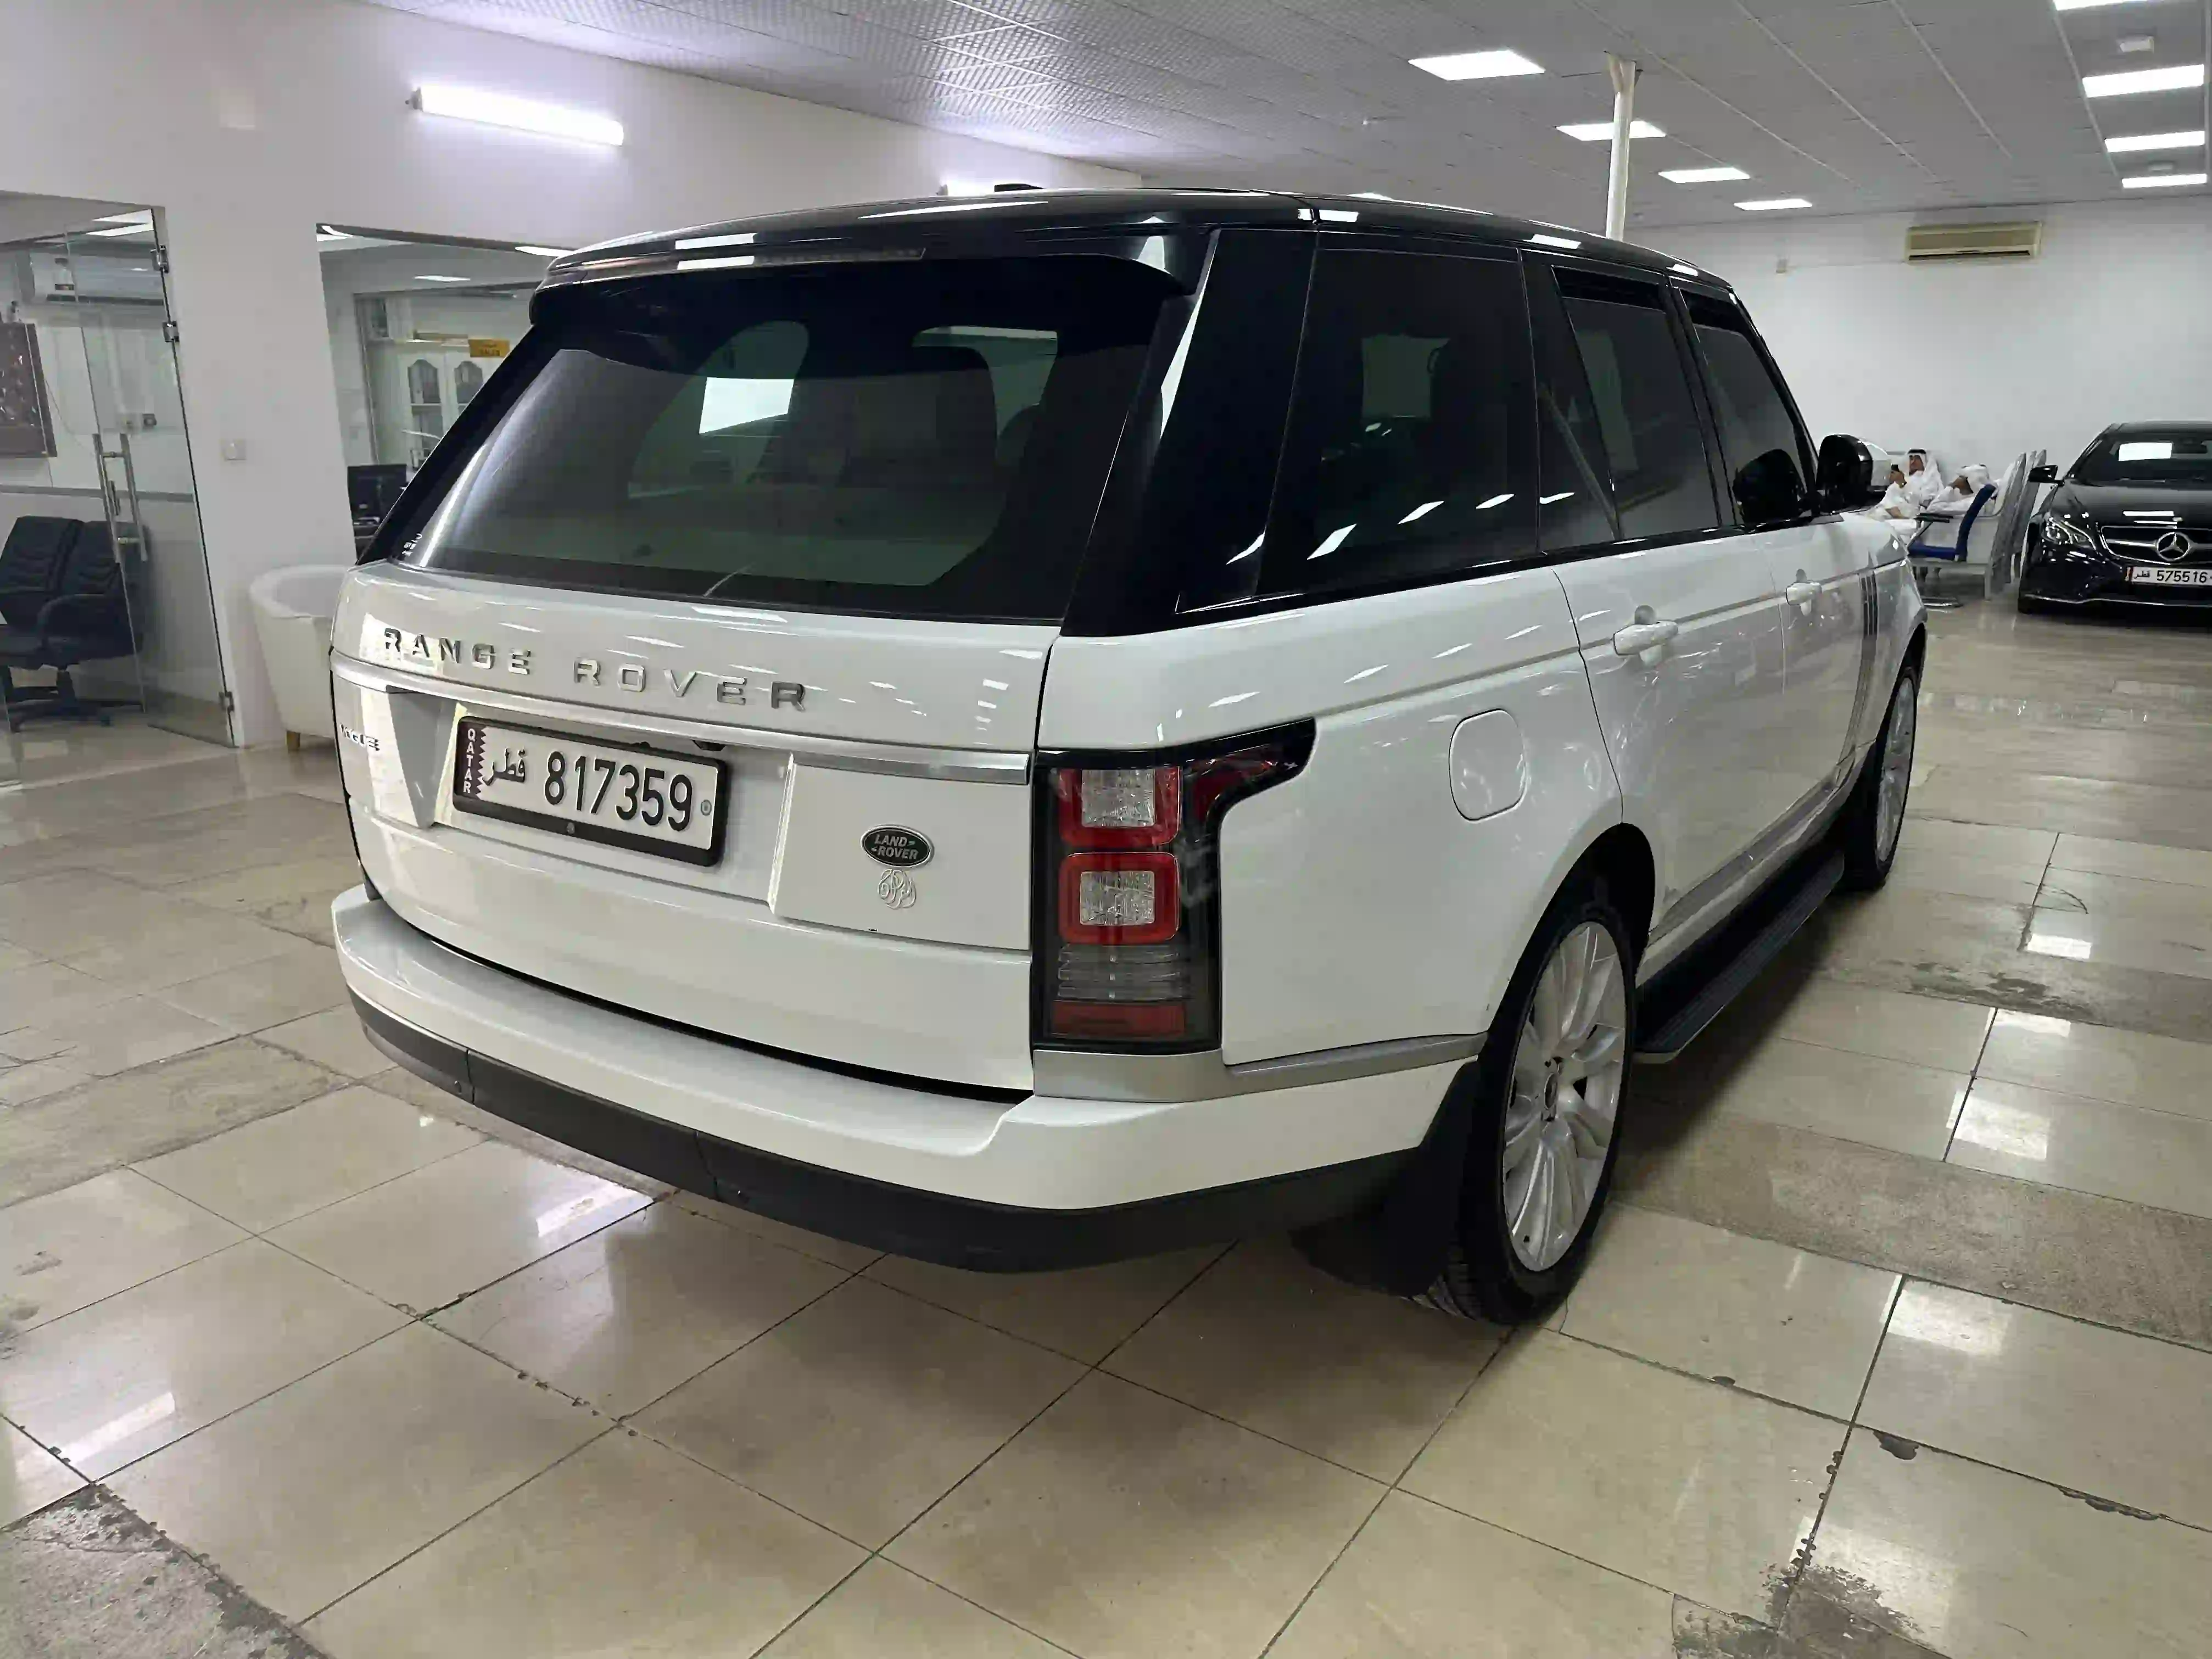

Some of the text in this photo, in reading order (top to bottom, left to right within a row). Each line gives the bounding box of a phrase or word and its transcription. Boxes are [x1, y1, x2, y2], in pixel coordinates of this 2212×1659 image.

[2157, 570, 2208, 583] 575516
[384, 628, 806, 711] RANGE ROVER
[463, 728, 476, 794] QATAR
[482, 747, 526, 786] قطر
[545, 751, 693, 831] 817359
[875, 834, 907, 846] LAND
[879, 846, 919, 859] ROVER
